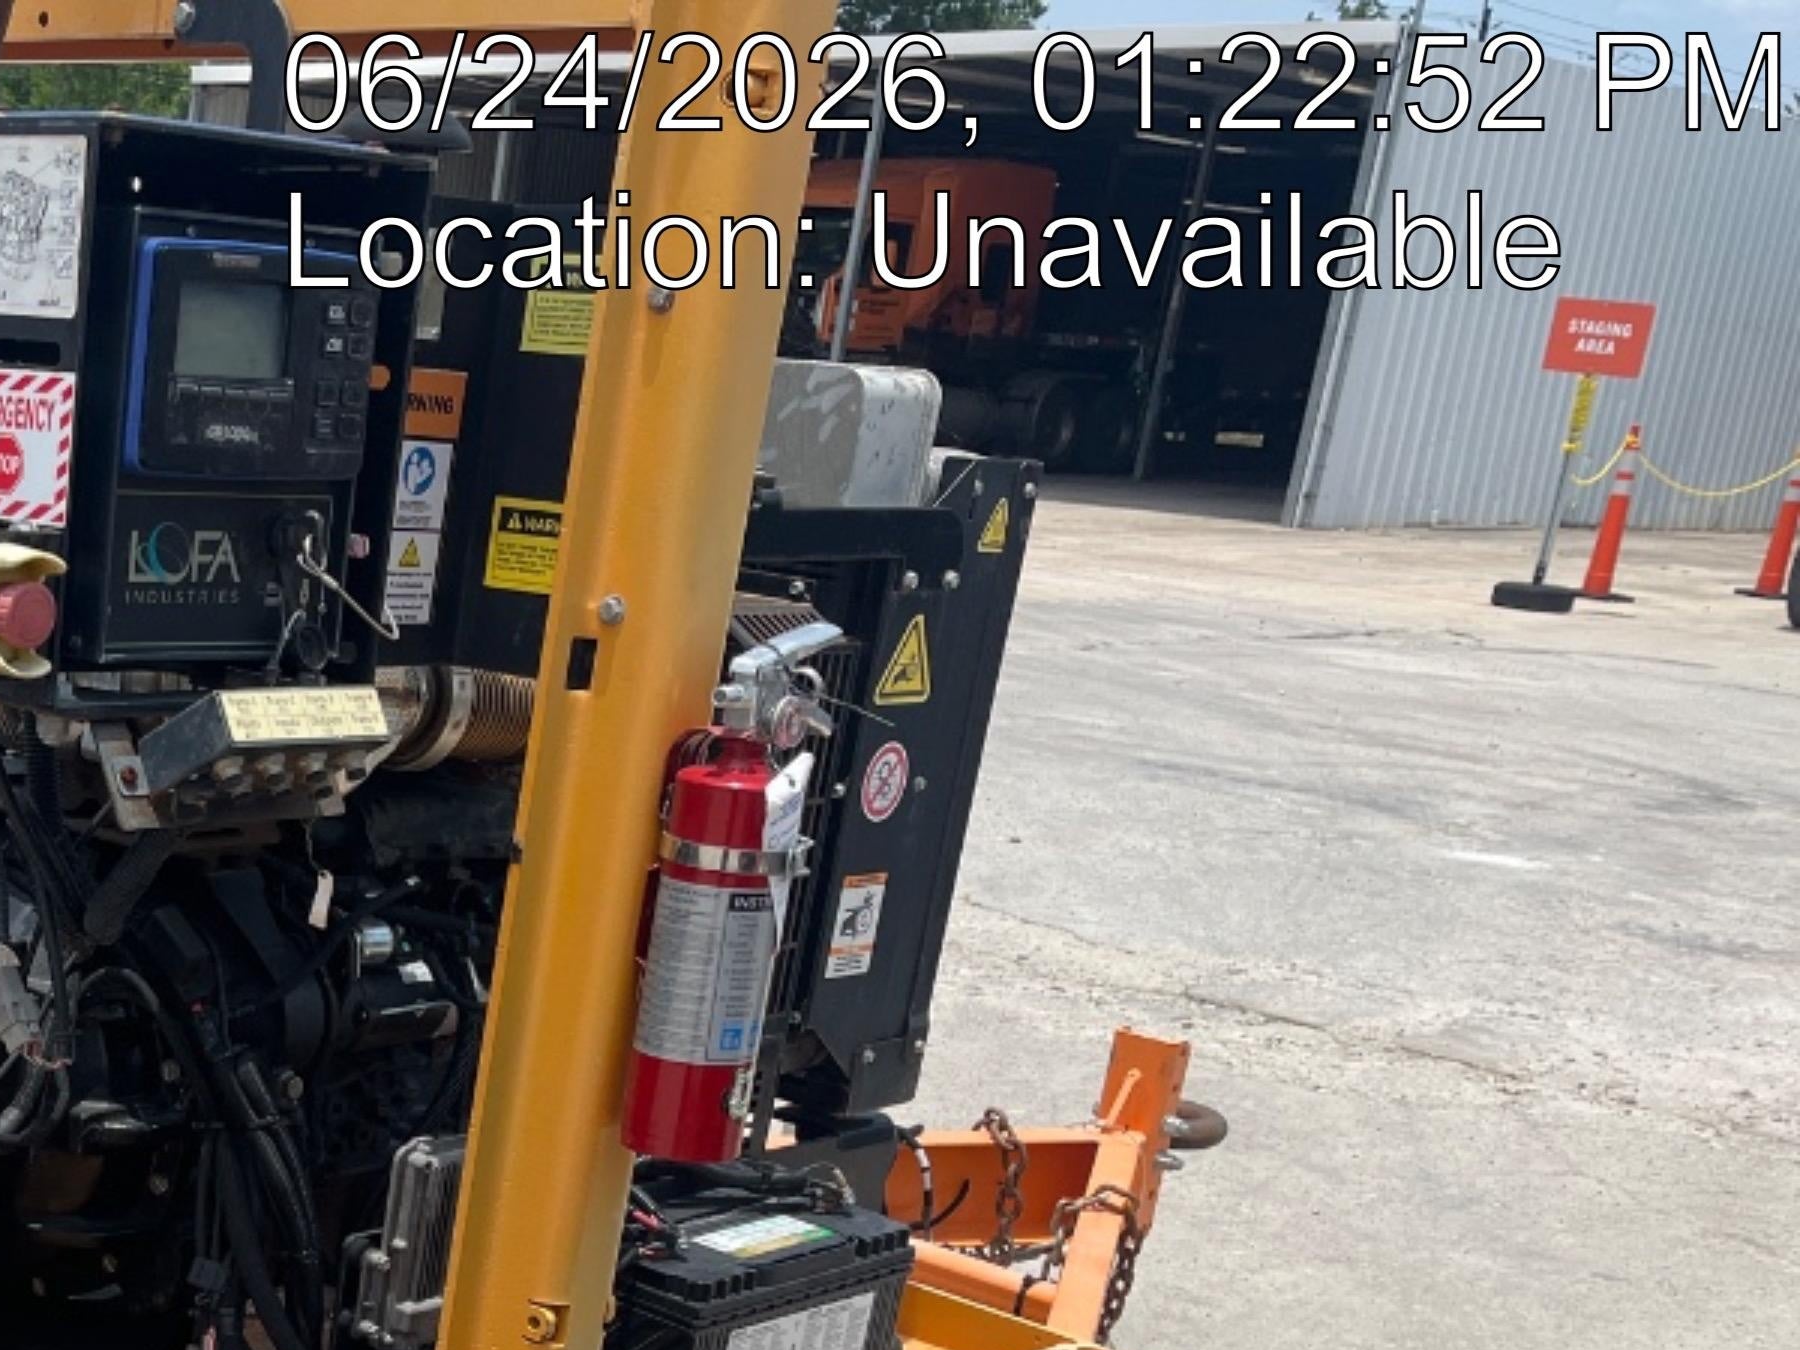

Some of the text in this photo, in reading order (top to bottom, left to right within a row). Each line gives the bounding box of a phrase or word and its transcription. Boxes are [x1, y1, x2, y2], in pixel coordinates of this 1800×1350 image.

[1567, 317, 1633, 338] STAGING
[1574, 338, 1616, 355] AREA
[406, 392, 454, 415] RNING
[125, 590, 241, 604] INDUSTRIES
